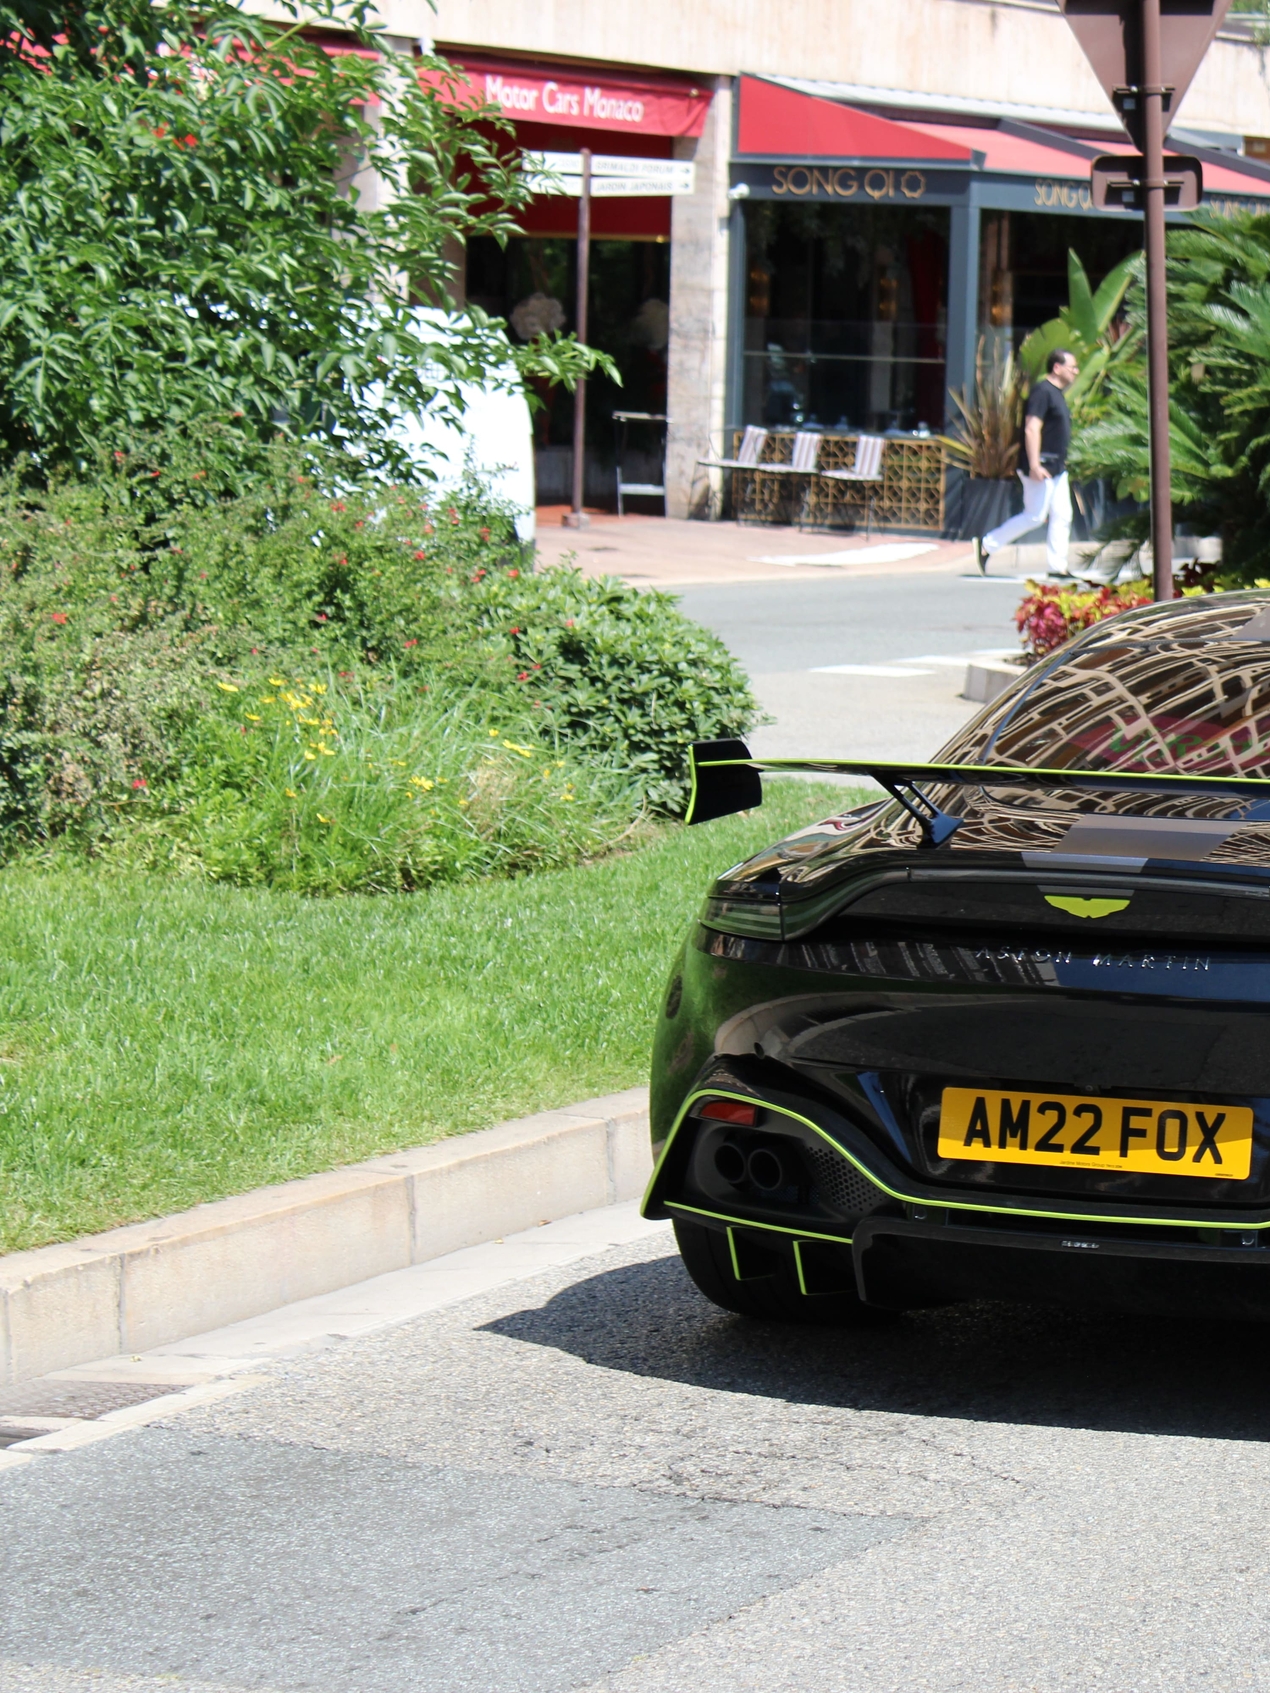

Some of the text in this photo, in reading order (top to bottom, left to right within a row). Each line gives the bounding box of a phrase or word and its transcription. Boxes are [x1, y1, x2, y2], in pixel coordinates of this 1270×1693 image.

[485, 74, 644, 123] Motor Cars Monaco
[595, 161, 675, 175] GRIMALDI FORUM
[771, 166, 895, 200] SONG QI
[595, 181, 673, 192] JARDIN JAPONAIS
[1034, 178, 1093, 211] SONG Q
[976, 946, 1210, 971] ASTON MARTIN
[963, 1096, 1226, 1165] AM22 FOX
